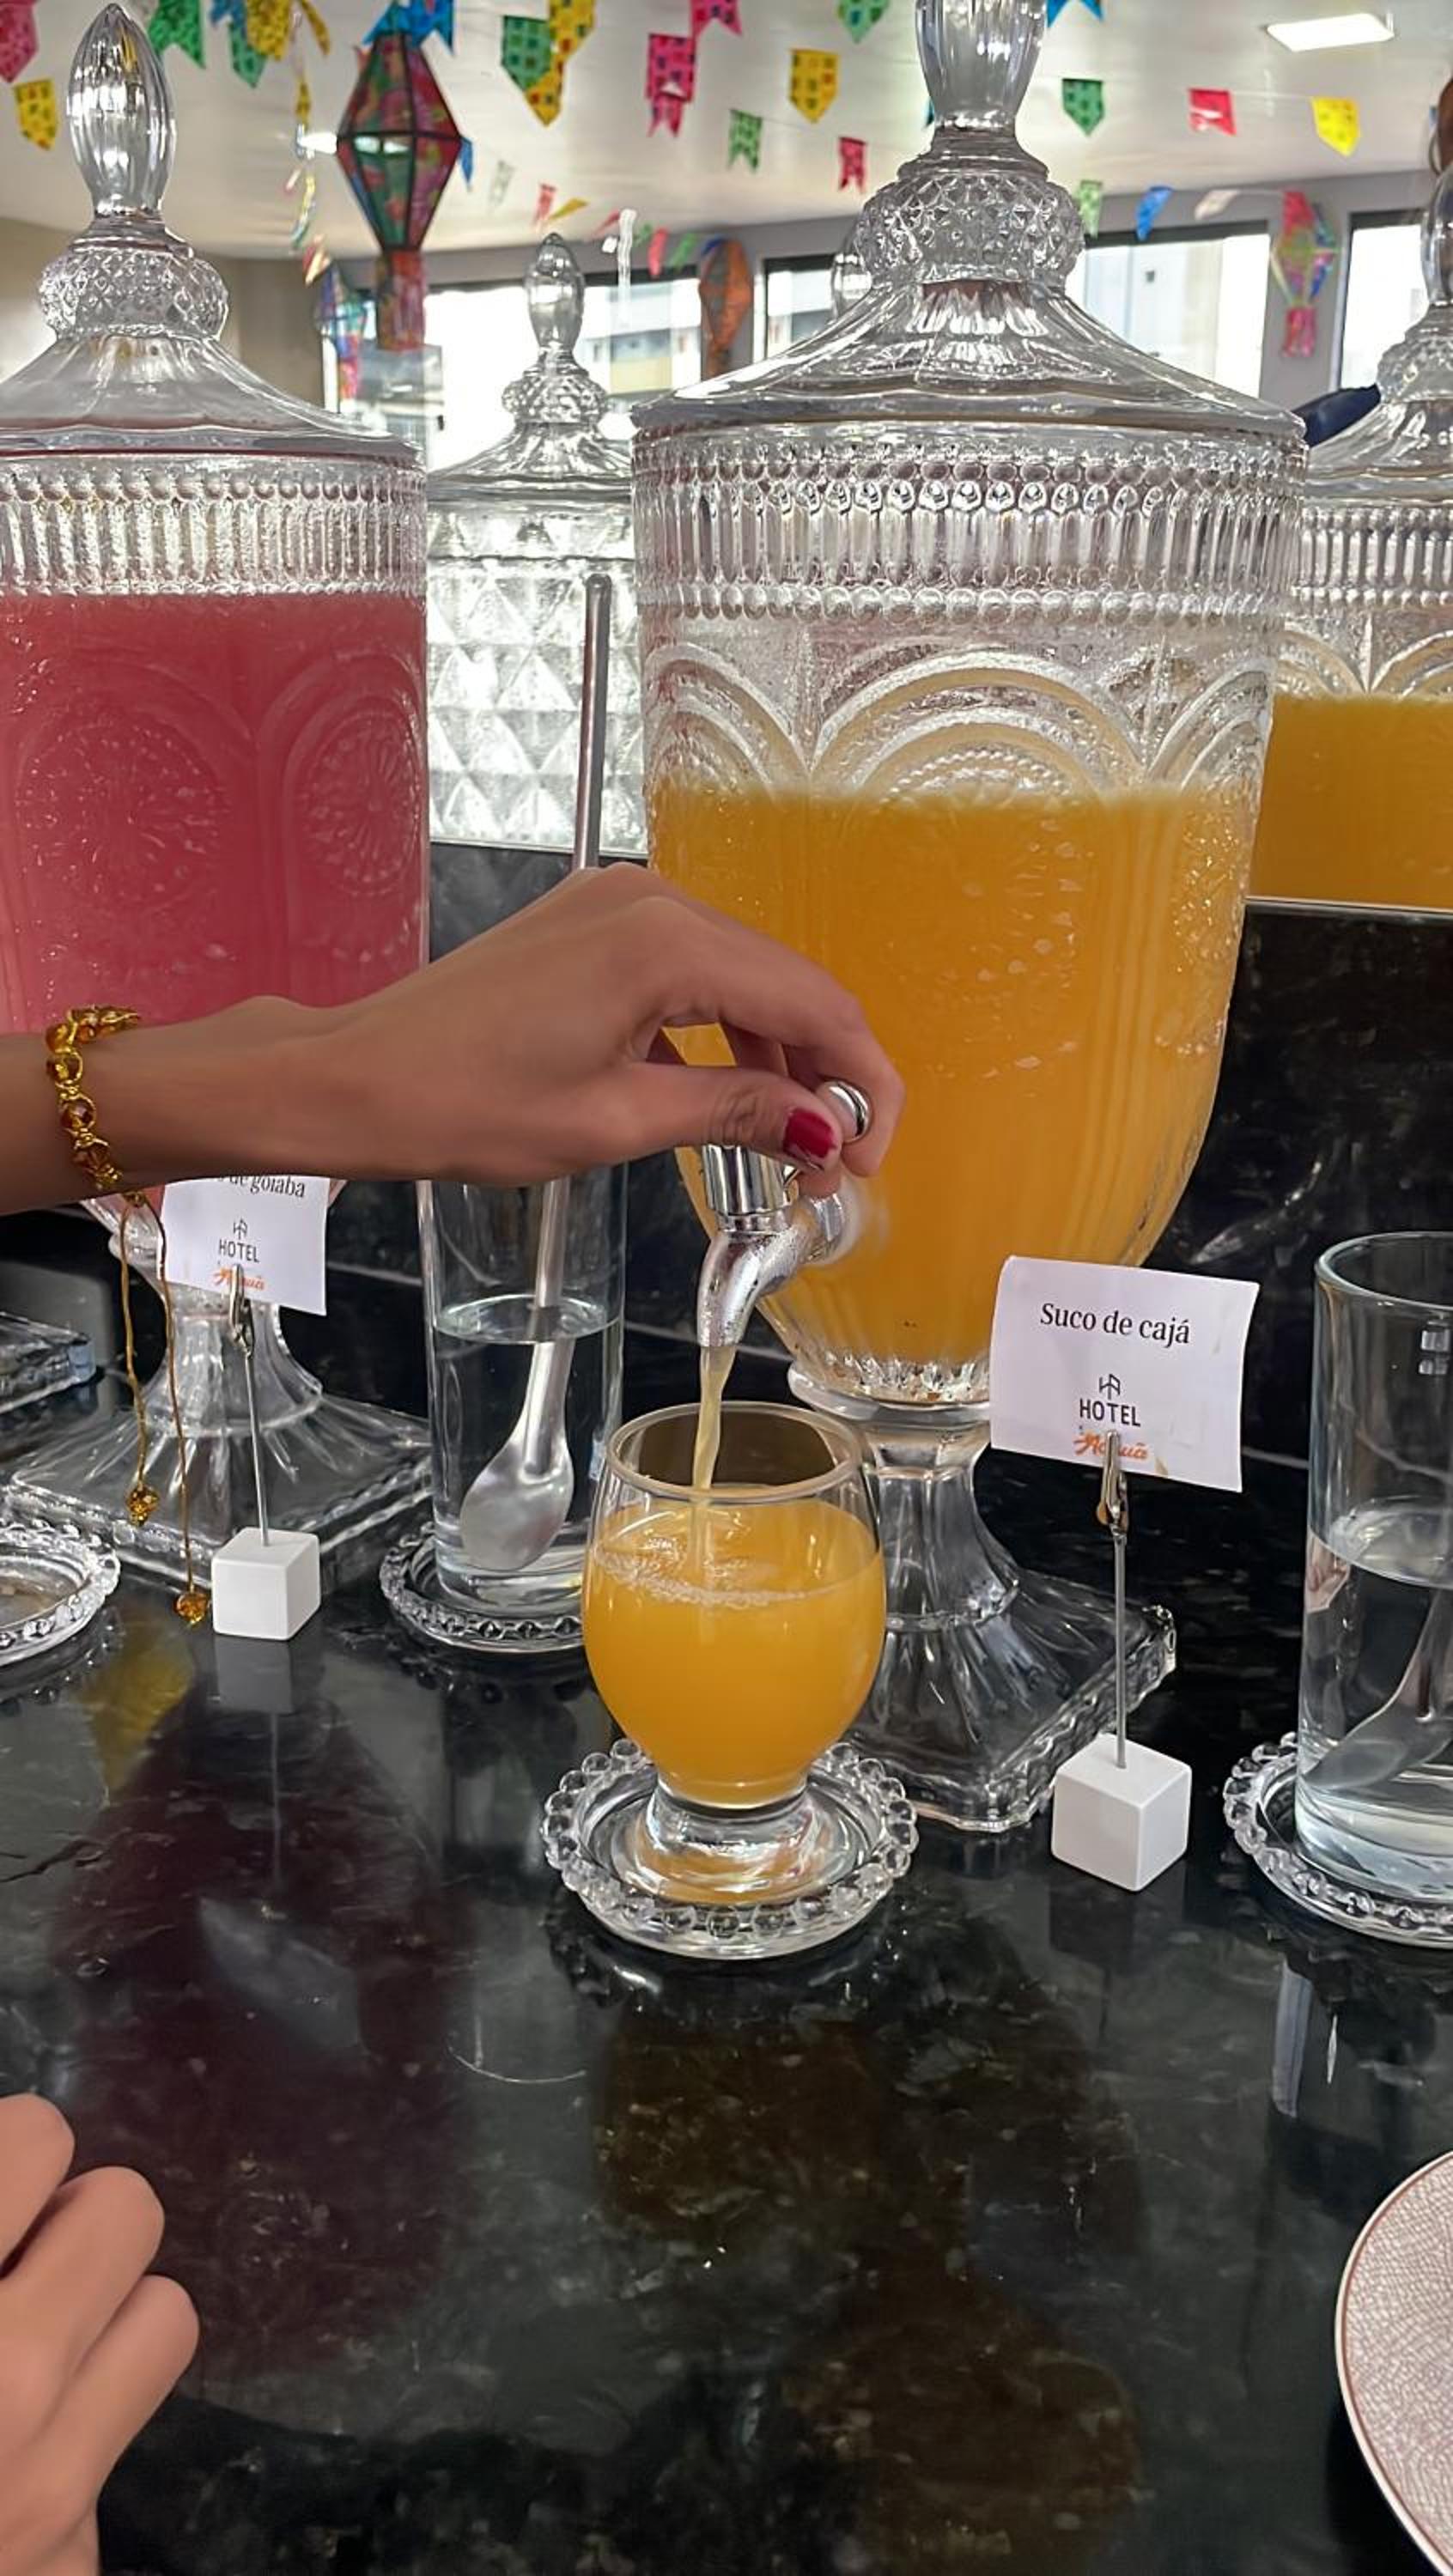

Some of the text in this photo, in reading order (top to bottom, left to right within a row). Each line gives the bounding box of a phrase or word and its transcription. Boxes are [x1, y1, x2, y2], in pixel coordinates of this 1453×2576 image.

[250, 1176, 305, 1198] goiaba
[219, 1239, 259, 1263] HOTEL
[1041, 1303, 1190, 1348] Suco de cajá
[1079, 1398, 1141, 1427] HOTEL
[1073, 1431, 1149, 1460] Acuã
